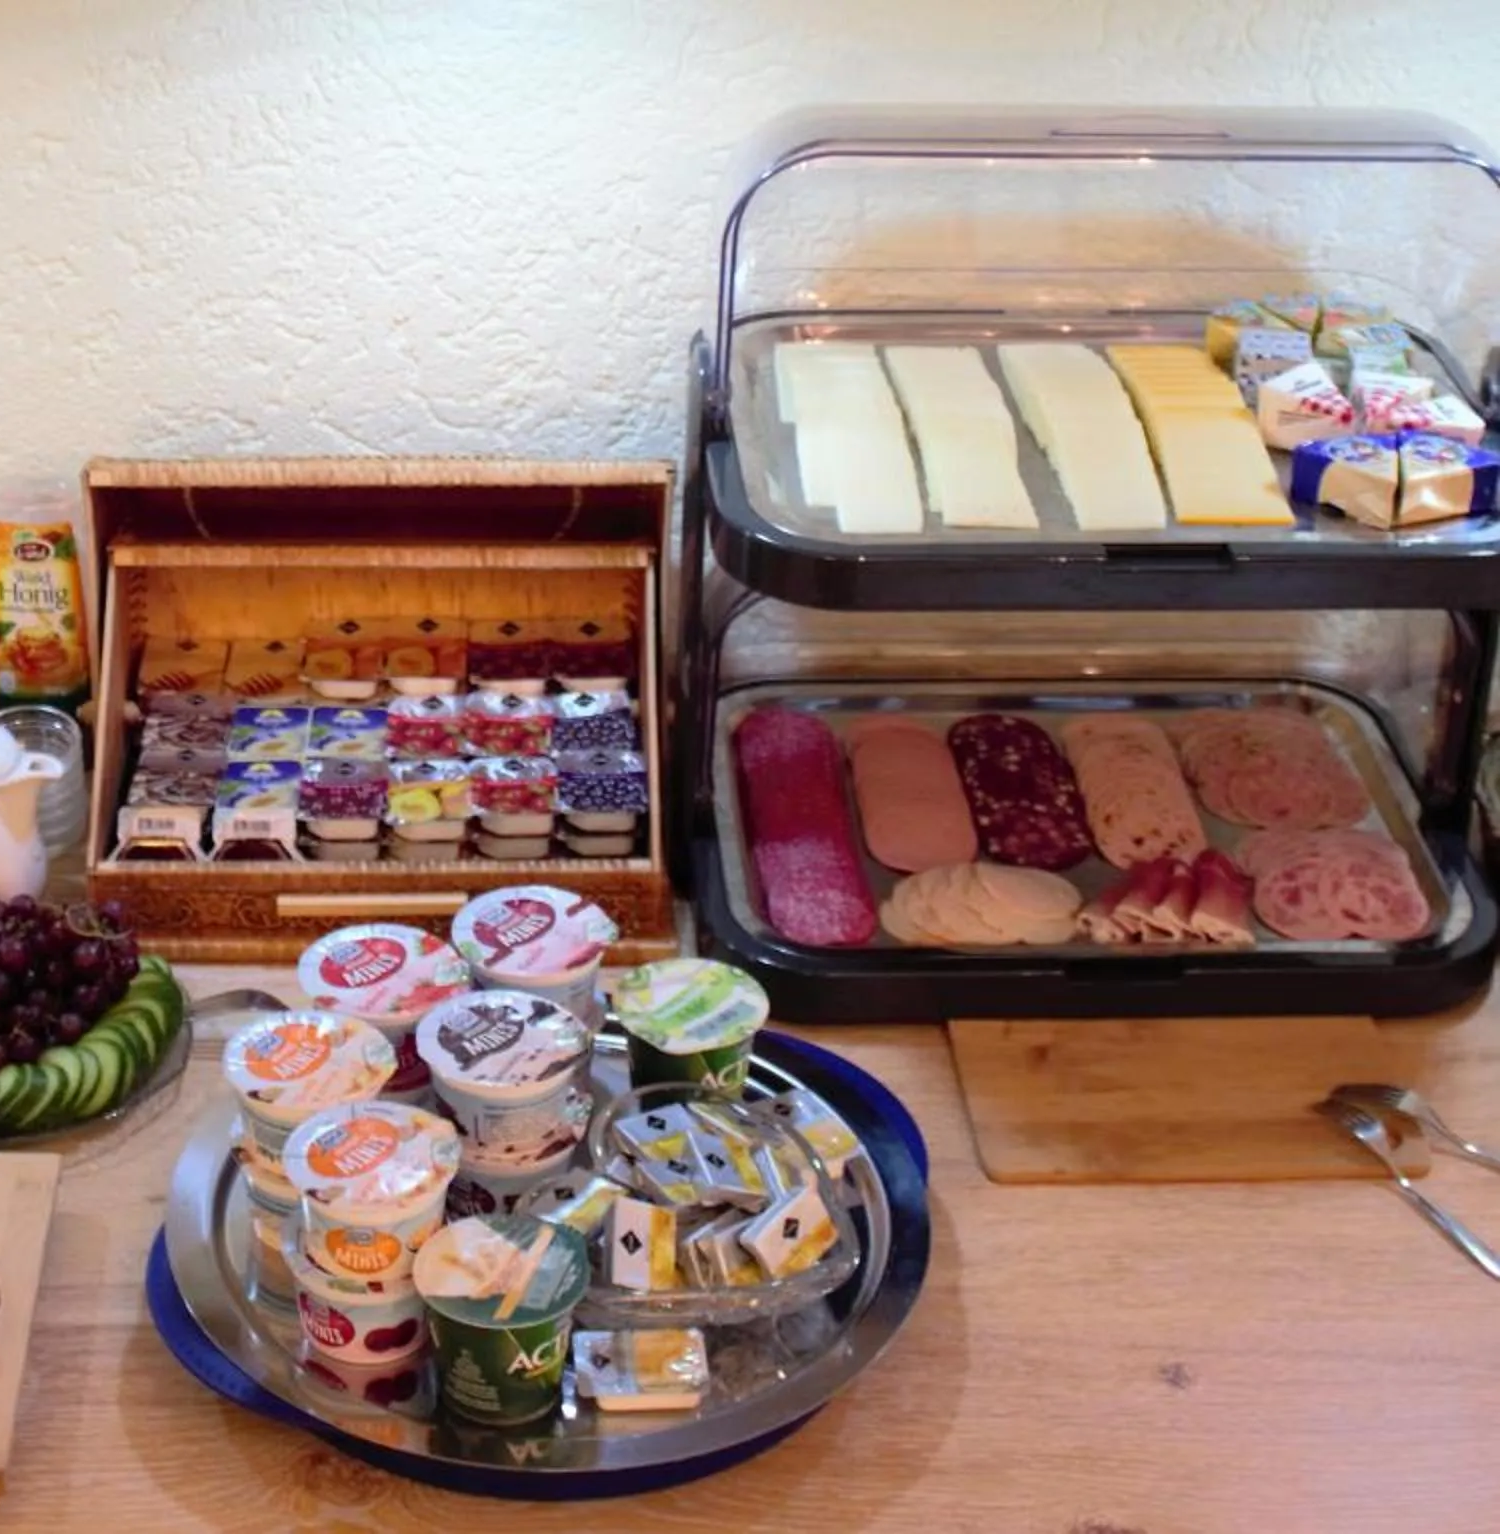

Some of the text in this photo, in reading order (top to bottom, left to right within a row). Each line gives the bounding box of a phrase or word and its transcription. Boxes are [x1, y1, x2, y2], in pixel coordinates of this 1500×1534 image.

[496, 912, 552, 948] MINIS
[341, 952, 402, 988] MINIS
[462, 1020, 520, 1057] MINIS
[333, 1133, 395, 1175] MINIS
[334, 1247, 391, 1271] MINIS
